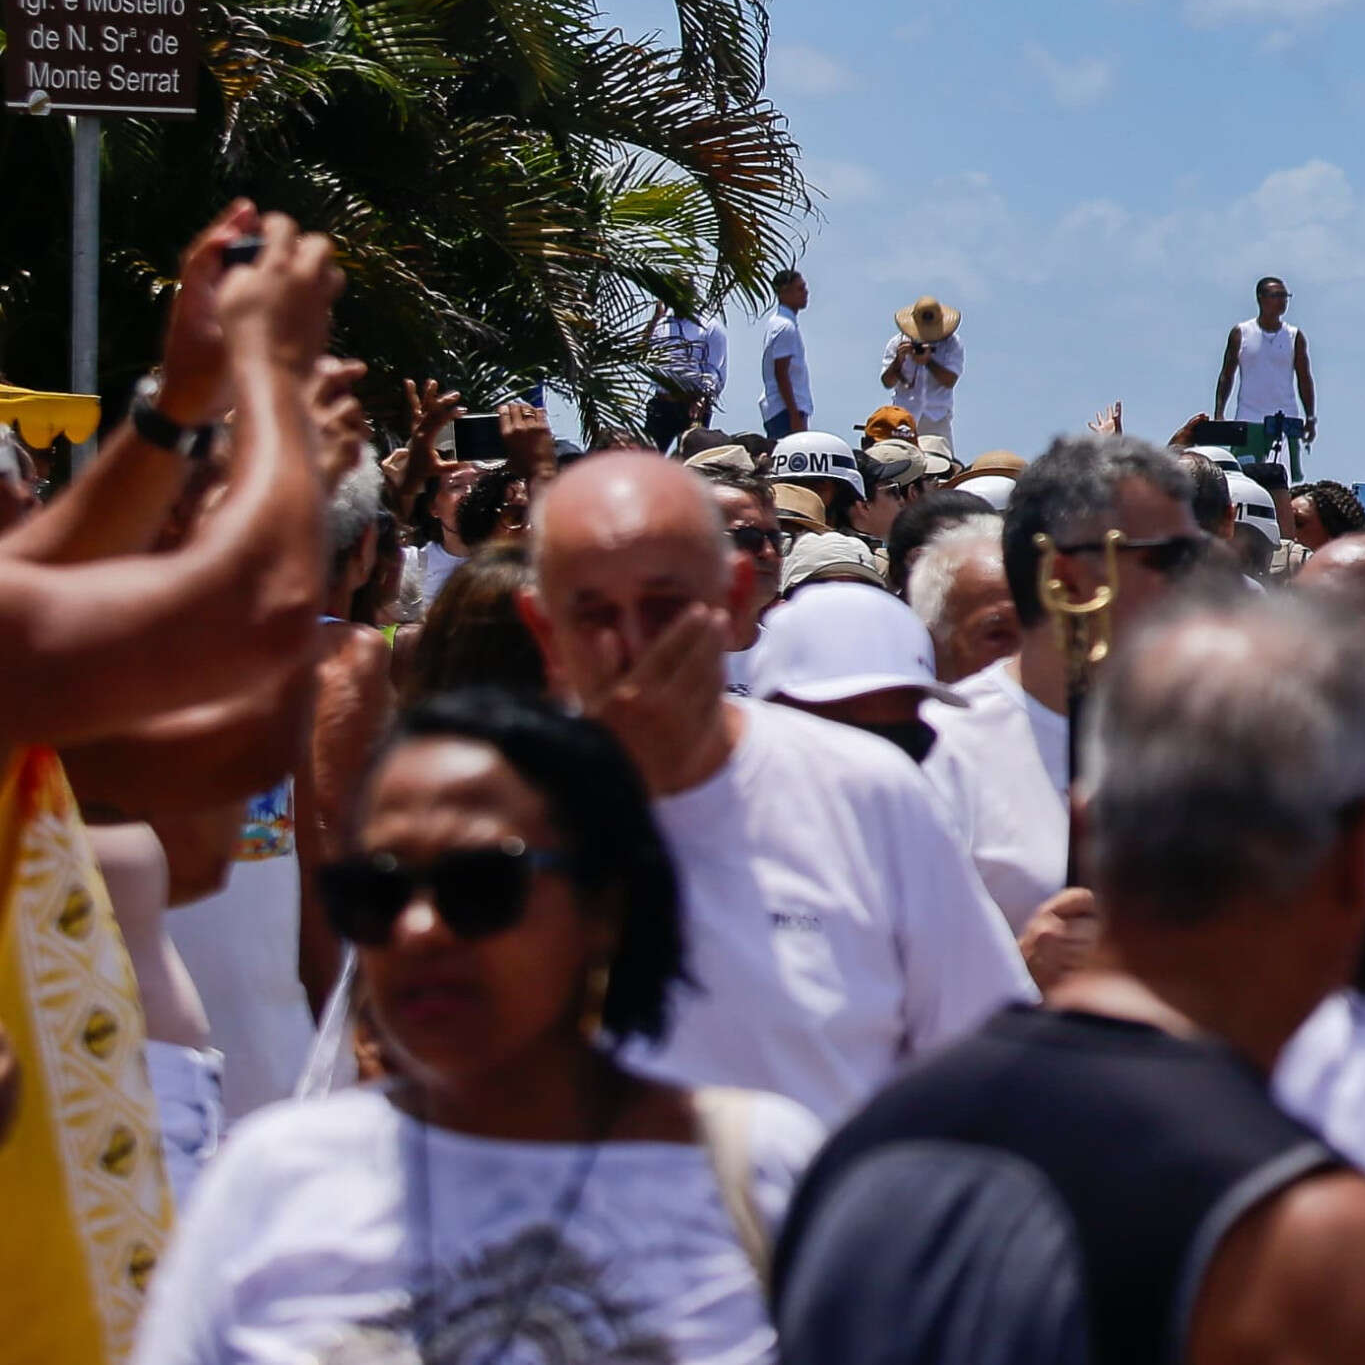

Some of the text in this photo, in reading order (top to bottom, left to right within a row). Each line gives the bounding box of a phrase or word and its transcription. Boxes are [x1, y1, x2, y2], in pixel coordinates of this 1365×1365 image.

[30, 23, 59, 50] de
[67, 25, 93, 51] N.
[150, 29, 179, 55] de
[28, 61, 180, 93] Monte Serrat
